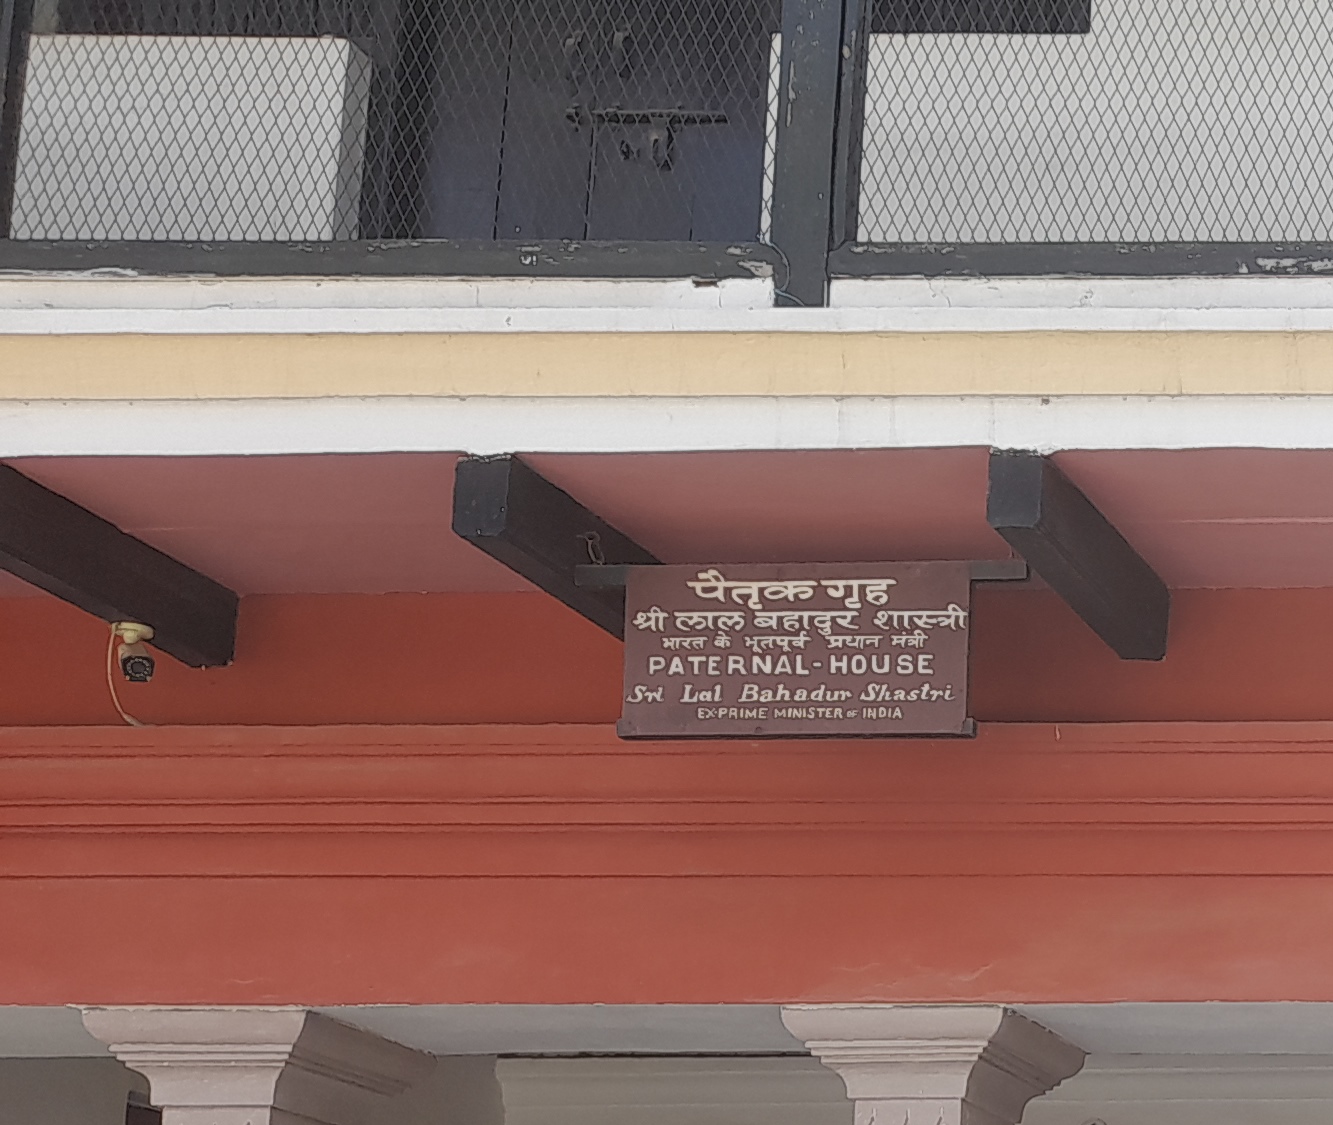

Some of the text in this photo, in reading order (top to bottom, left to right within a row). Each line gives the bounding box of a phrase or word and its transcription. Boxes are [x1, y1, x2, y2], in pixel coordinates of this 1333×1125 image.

[687, 570, 896, 609] पैतृक गृह
[633, 604, 967, 637] श्री लाल बहादुर शास्त्री
[662, 630, 928, 653] भारत के भूतपूर्व प्रधान मंत्री
[680, 685, 722, 703] Lal
[739, 684, 852, 703] Bahadur
[860, 684, 956, 702] Shastri
[774, 708, 843, 719] MINISTER
[862, 708, 902, 719] INDIA
